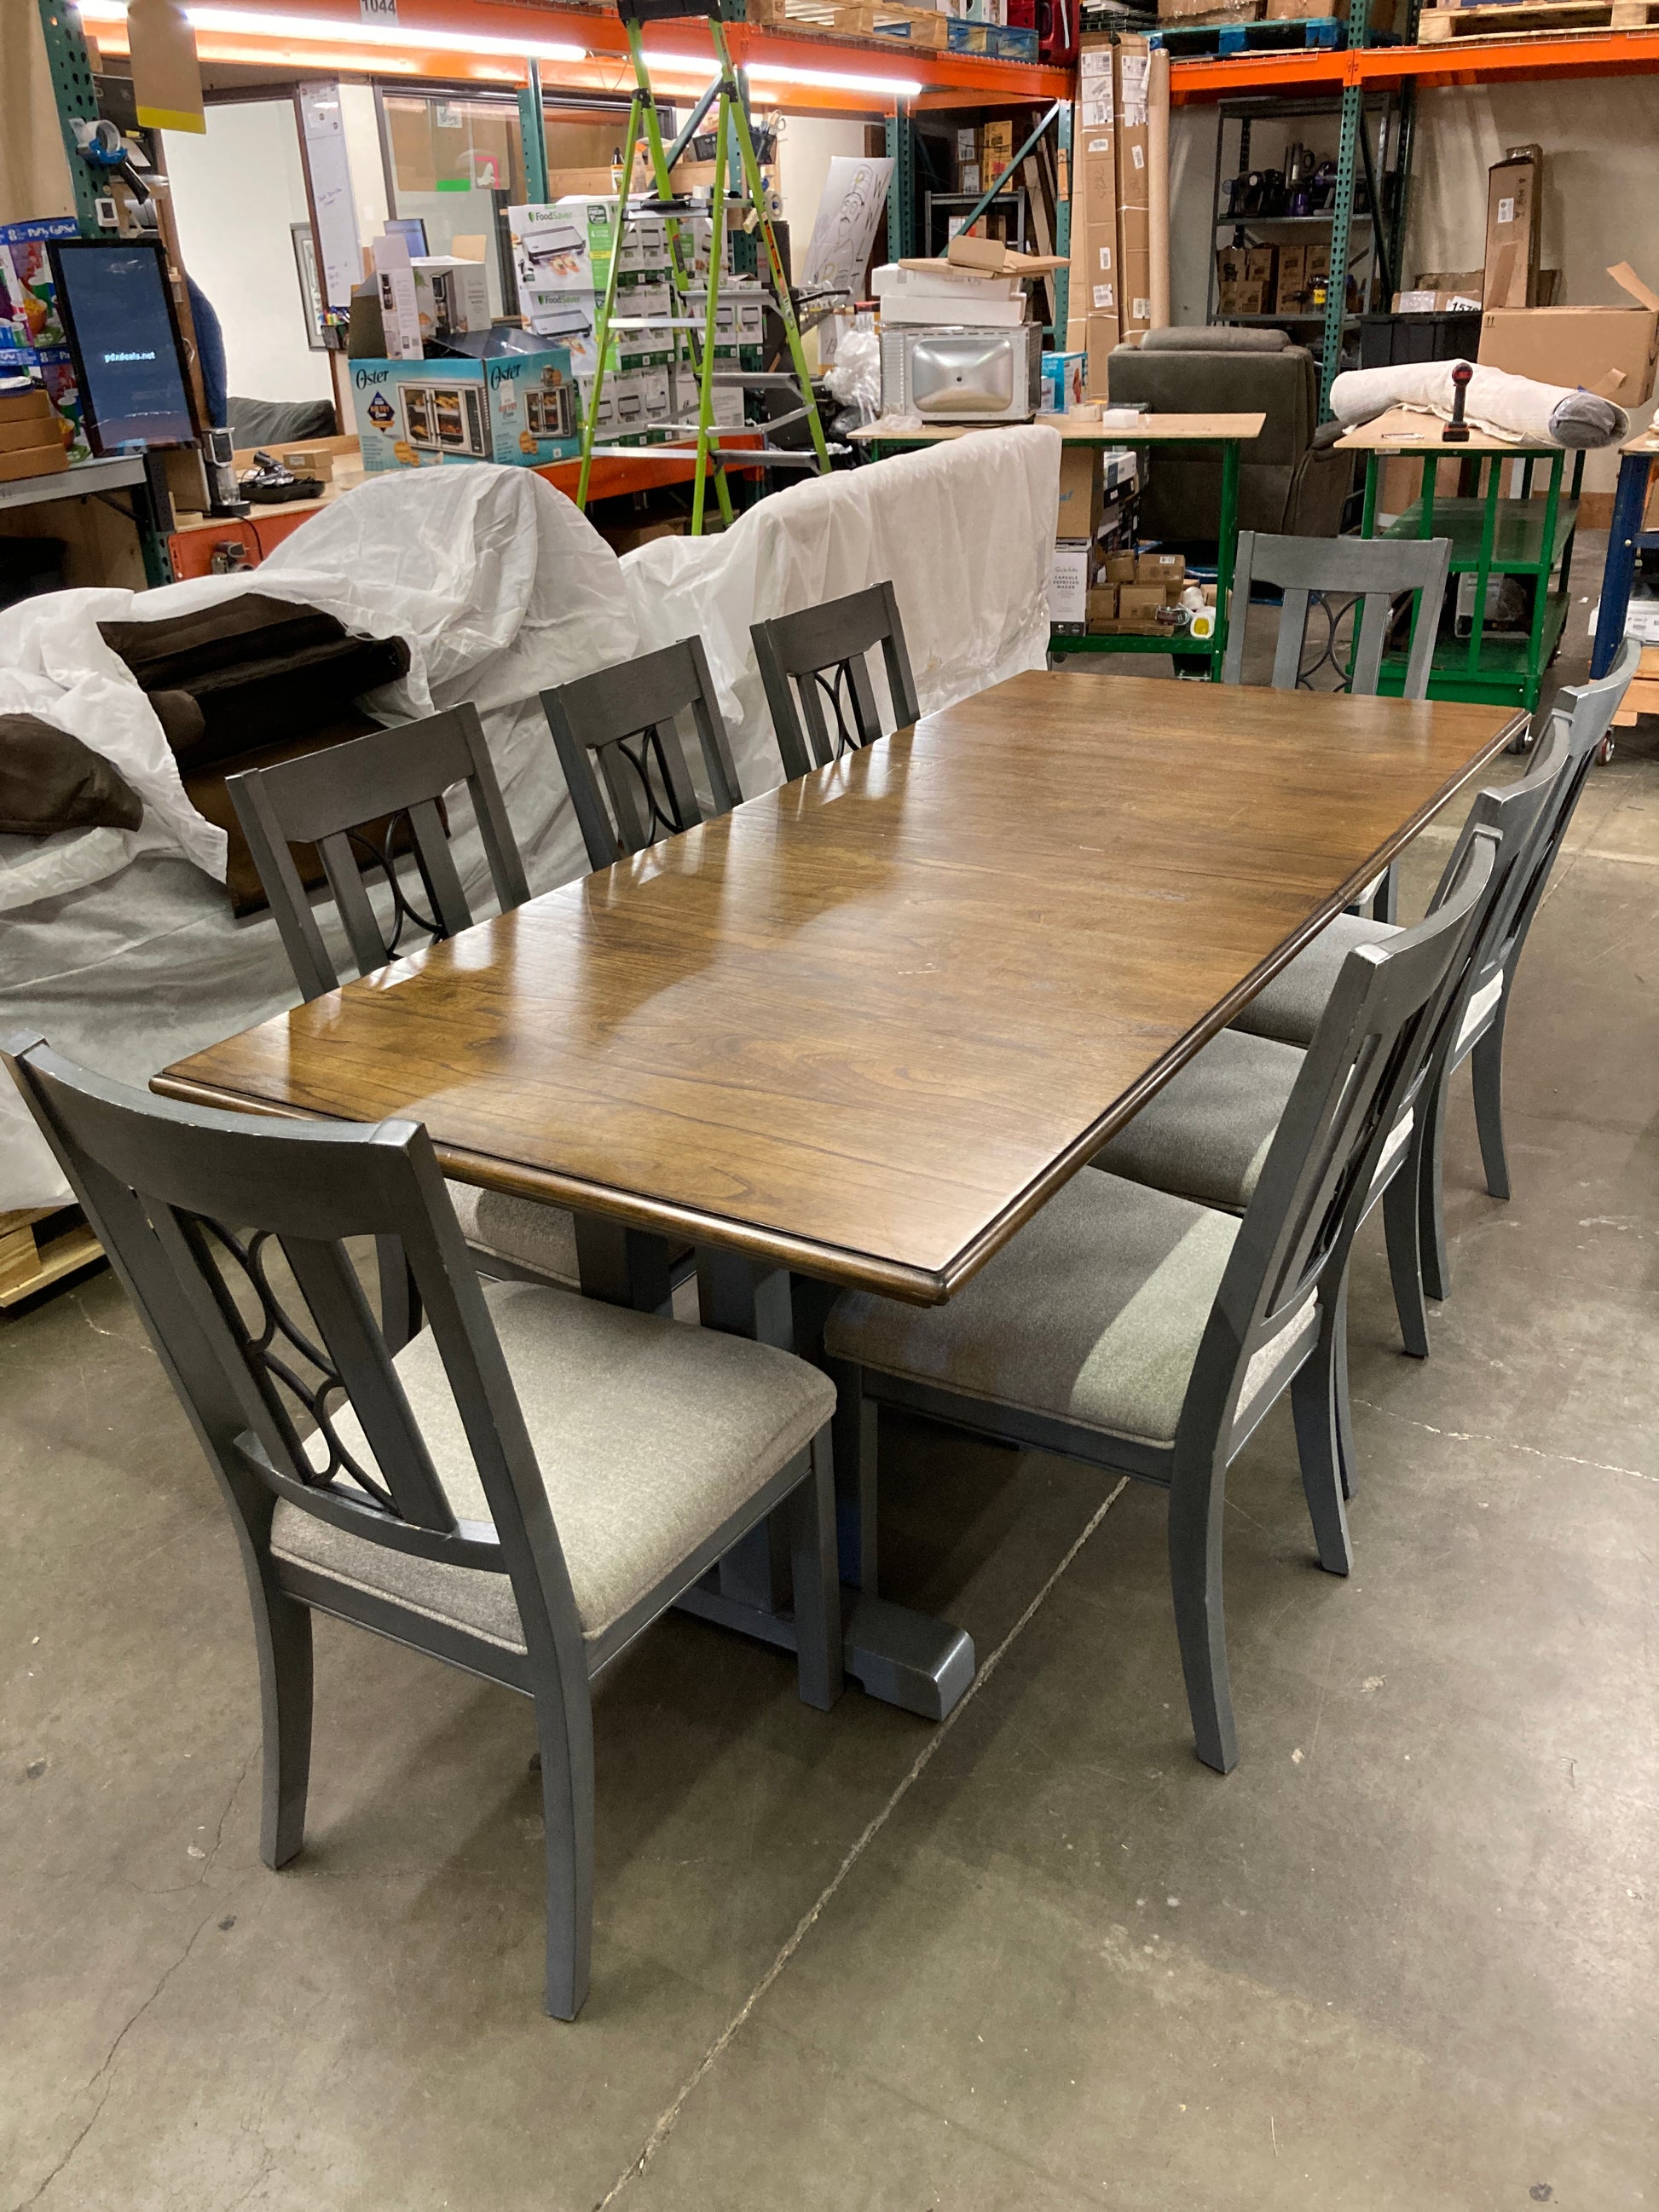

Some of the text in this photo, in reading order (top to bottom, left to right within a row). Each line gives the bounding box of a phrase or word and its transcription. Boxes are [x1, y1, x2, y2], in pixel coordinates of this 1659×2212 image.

[361, 0, 396, 14] 1044
[535, 211, 573, 221] FoodSaver
[356, 368, 390, 390] Oster
[491, 364, 521, 390] Oster
